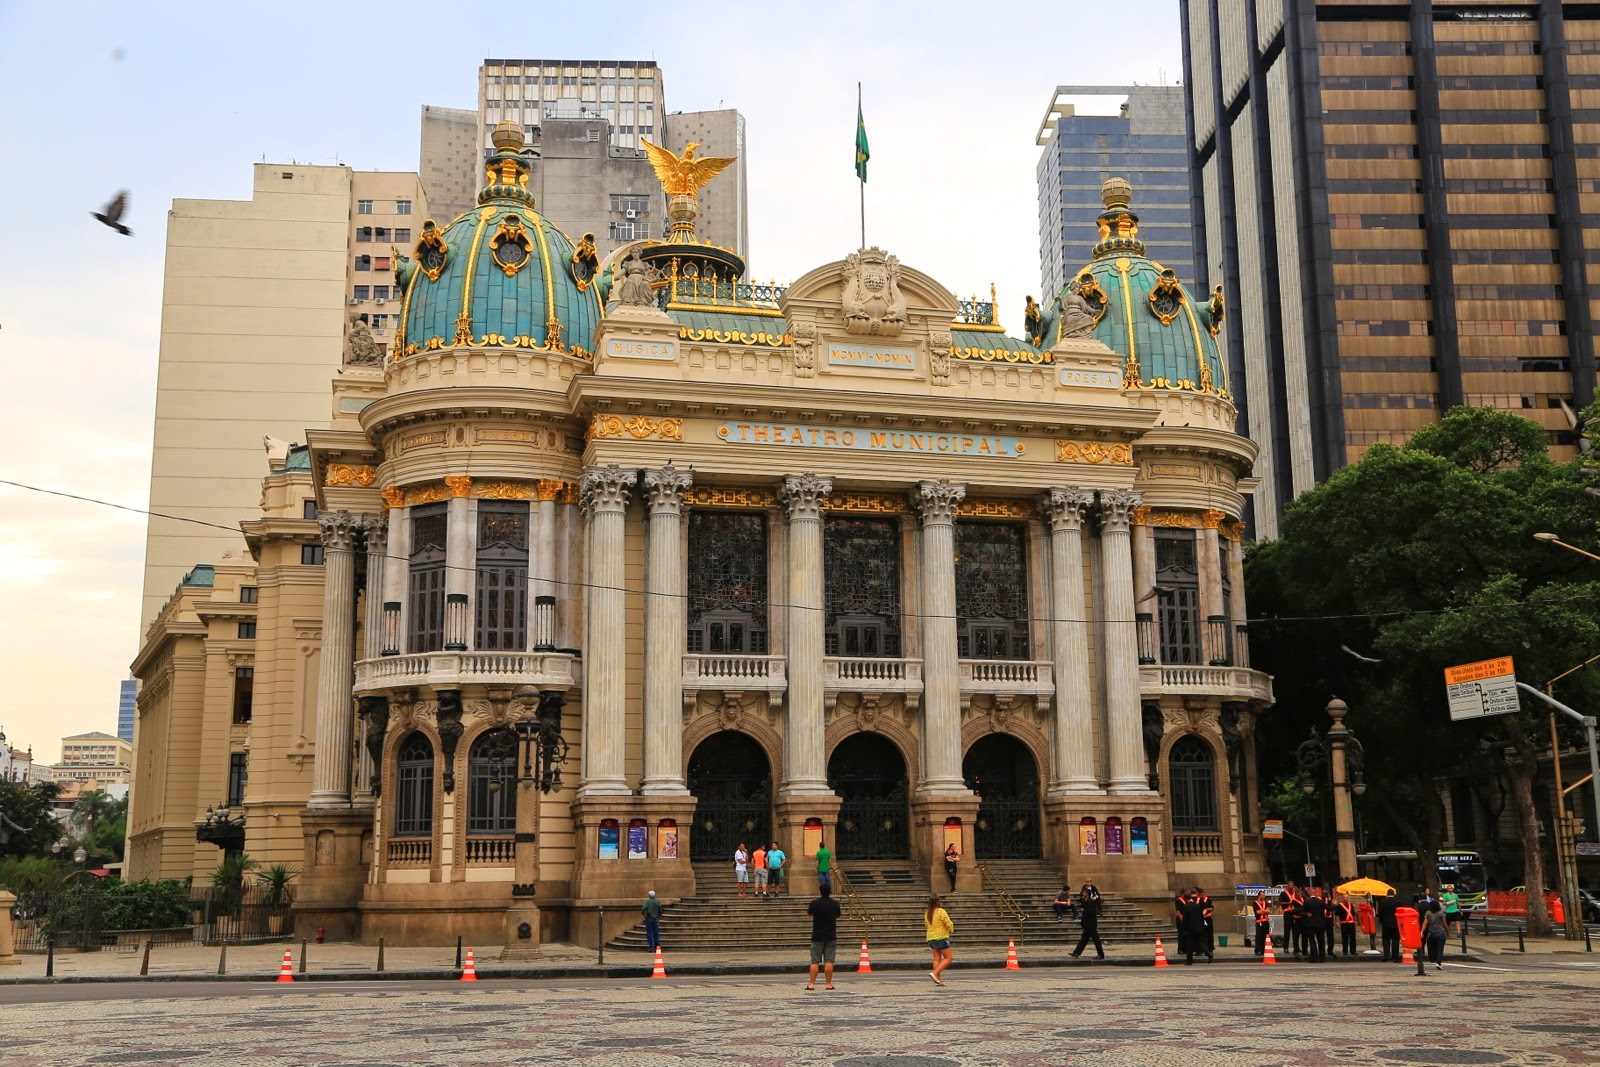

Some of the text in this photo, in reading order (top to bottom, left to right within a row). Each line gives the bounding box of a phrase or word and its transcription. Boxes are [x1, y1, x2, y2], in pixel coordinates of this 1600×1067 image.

[614, 343, 669, 356] MUSICA
[1067, 372, 1113, 385] POESIA
[736, 424, 1009, 455] THEATRO MUNICIPAL
